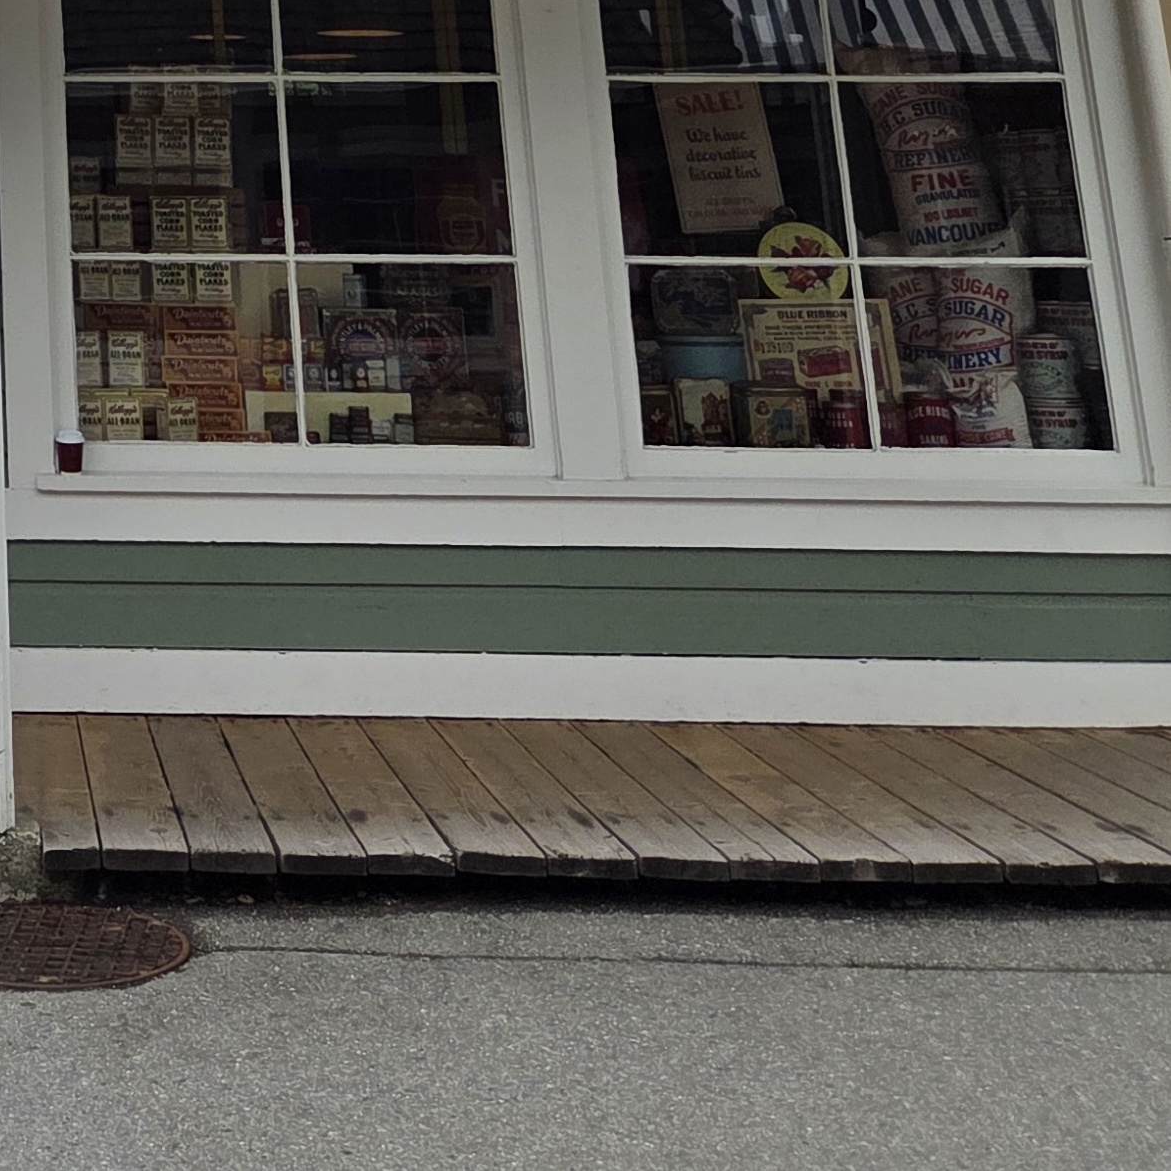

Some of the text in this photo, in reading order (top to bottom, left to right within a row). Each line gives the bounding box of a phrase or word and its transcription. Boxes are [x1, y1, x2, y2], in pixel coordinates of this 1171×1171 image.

[675, 89, 744, 117] SALE!
[686, 126, 747, 143] We have
[734, 165, 762, 179] tins
[911, 169, 975, 193] FINE
[888, 276, 923, 303] ANE
[950, 277, 1010, 306] SUGAR
[777, 310, 847, 320] BLUE RIBBON
[944, 300, 1006, 328] SUGAR
[948, 347, 1003, 369] INERY
